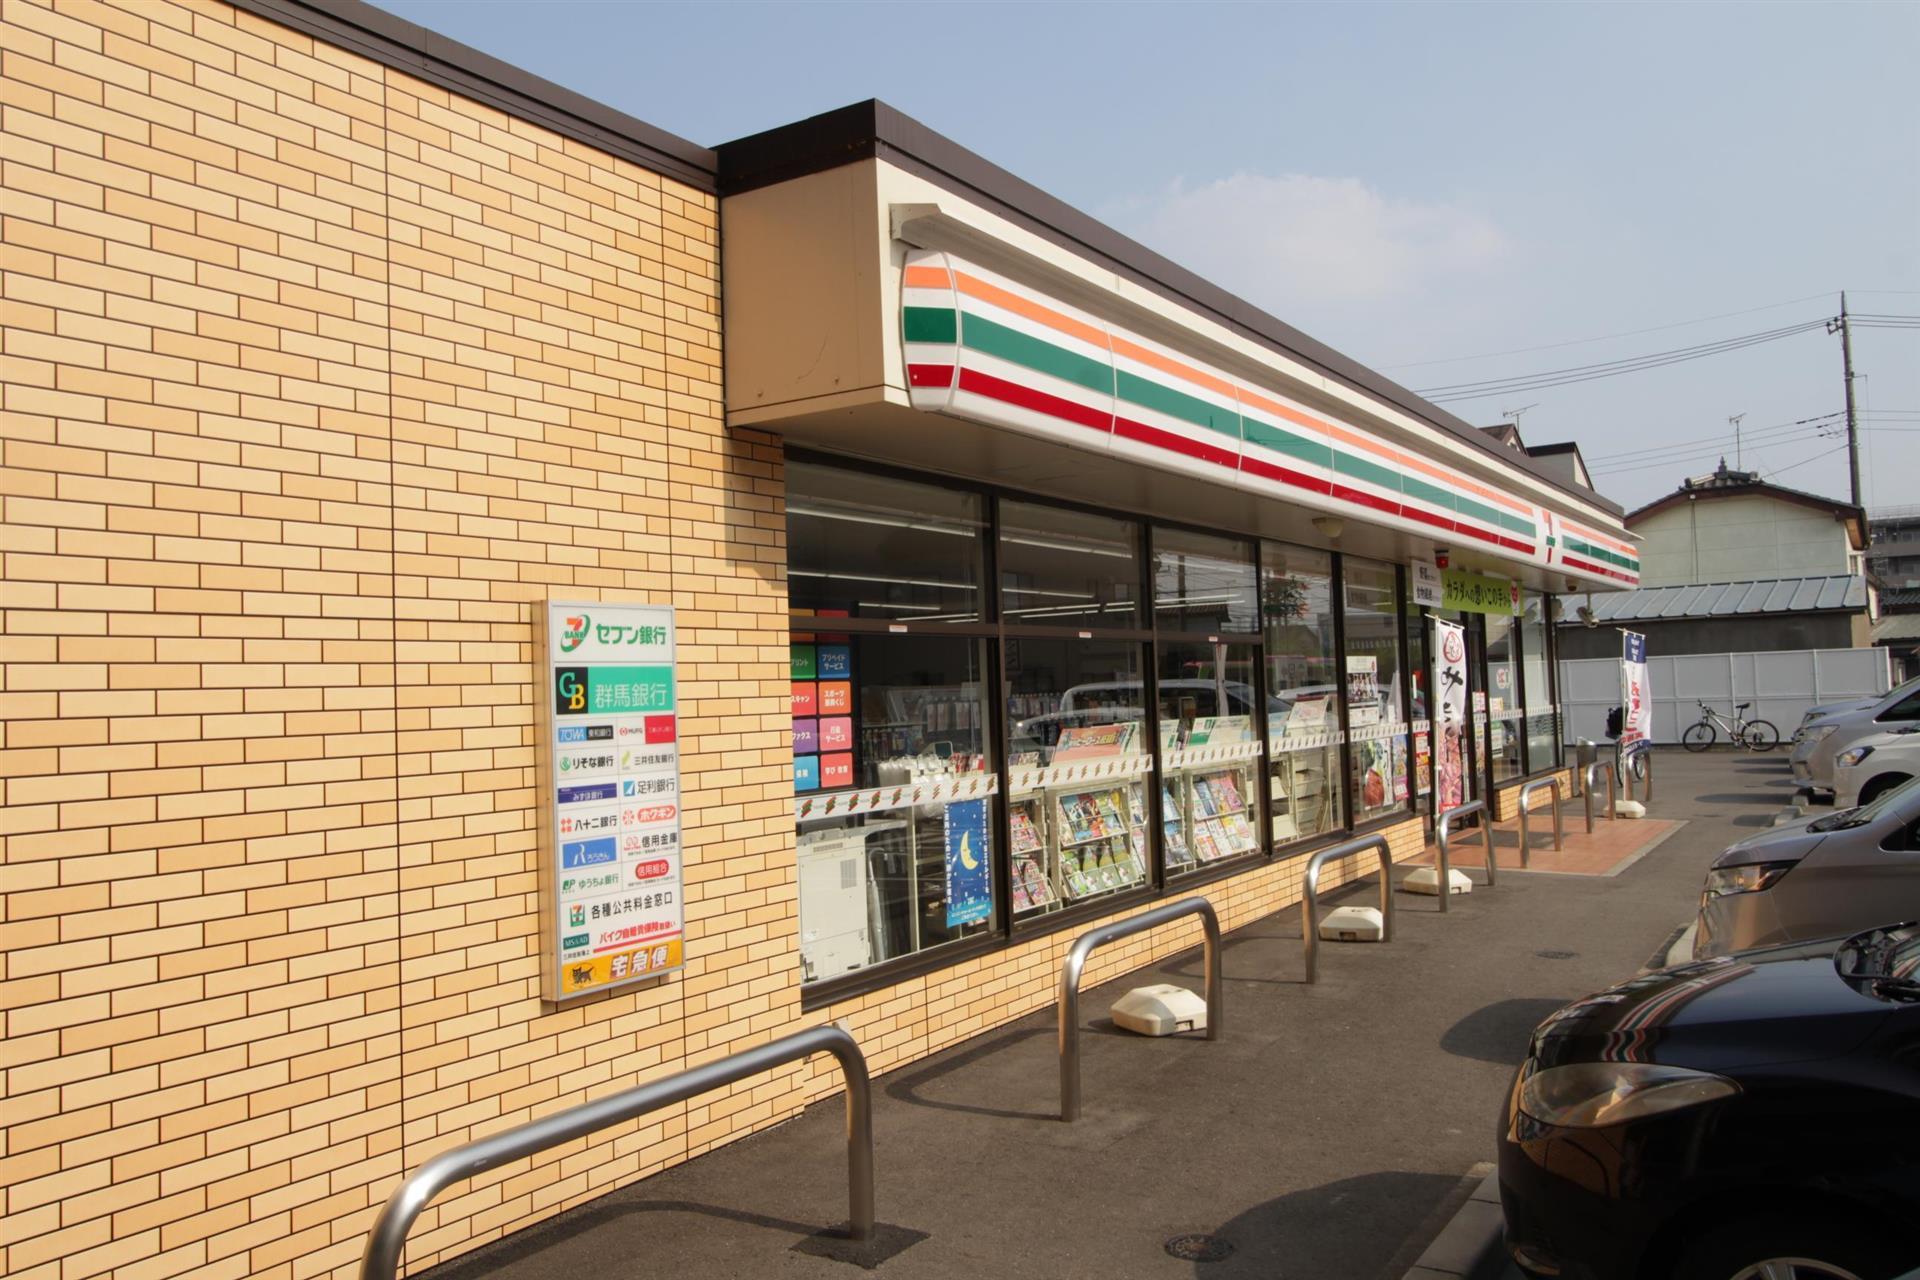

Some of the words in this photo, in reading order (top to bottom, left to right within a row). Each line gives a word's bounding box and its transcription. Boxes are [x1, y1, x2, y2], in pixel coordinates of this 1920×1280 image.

[596, 623, 667, 645] セブン銀行
[824, 662, 844, 671] サービス
[595, 683, 667, 709] 群馬銀行
[559, 728, 585, 741] TOWA
[573, 756, 614, 769] りそな銀行
[634, 753, 674, 766] 三井住友銀行
[637, 778, 675, 794] 足利銀行
[573, 790, 603, 801] みずほ銀行
[574, 815, 617, 831] 八十二銀行
[642, 832, 677, 848] 信用金庫
[637, 862, 667, 877] 信用組合
[579, 874, 619, 889] ゆうちょ銀行
[591, 892, 673, 920] 各種公共料金窓口
[610, 944, 668, 979] 宅急便
